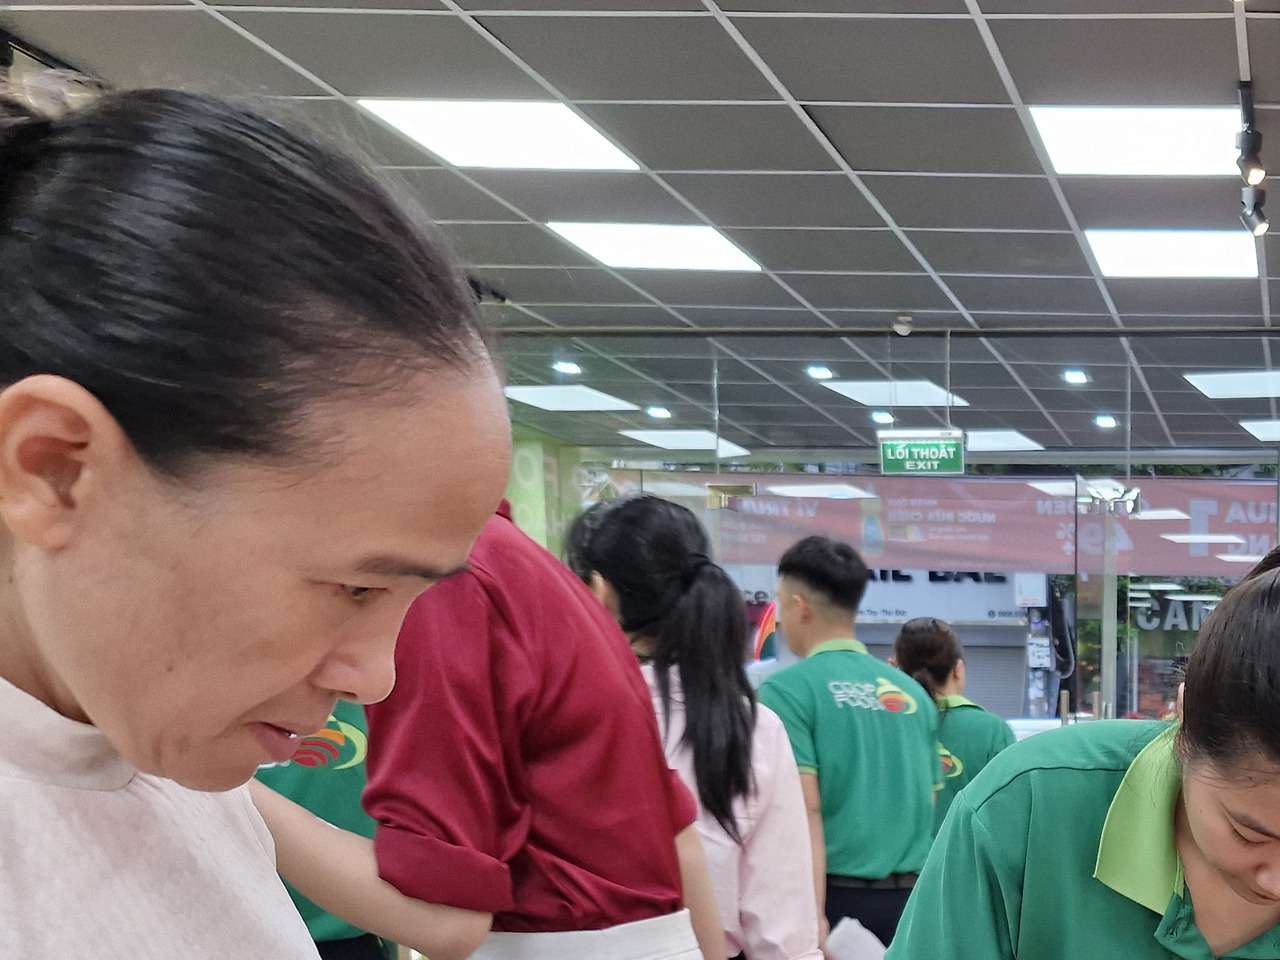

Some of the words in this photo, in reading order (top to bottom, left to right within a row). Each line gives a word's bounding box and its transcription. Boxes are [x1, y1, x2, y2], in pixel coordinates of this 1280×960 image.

[887, 444, 909, 459] LỐI
[911, 444, 956, 459] THOÁT
[905, 461, 940, 470] EXIT
